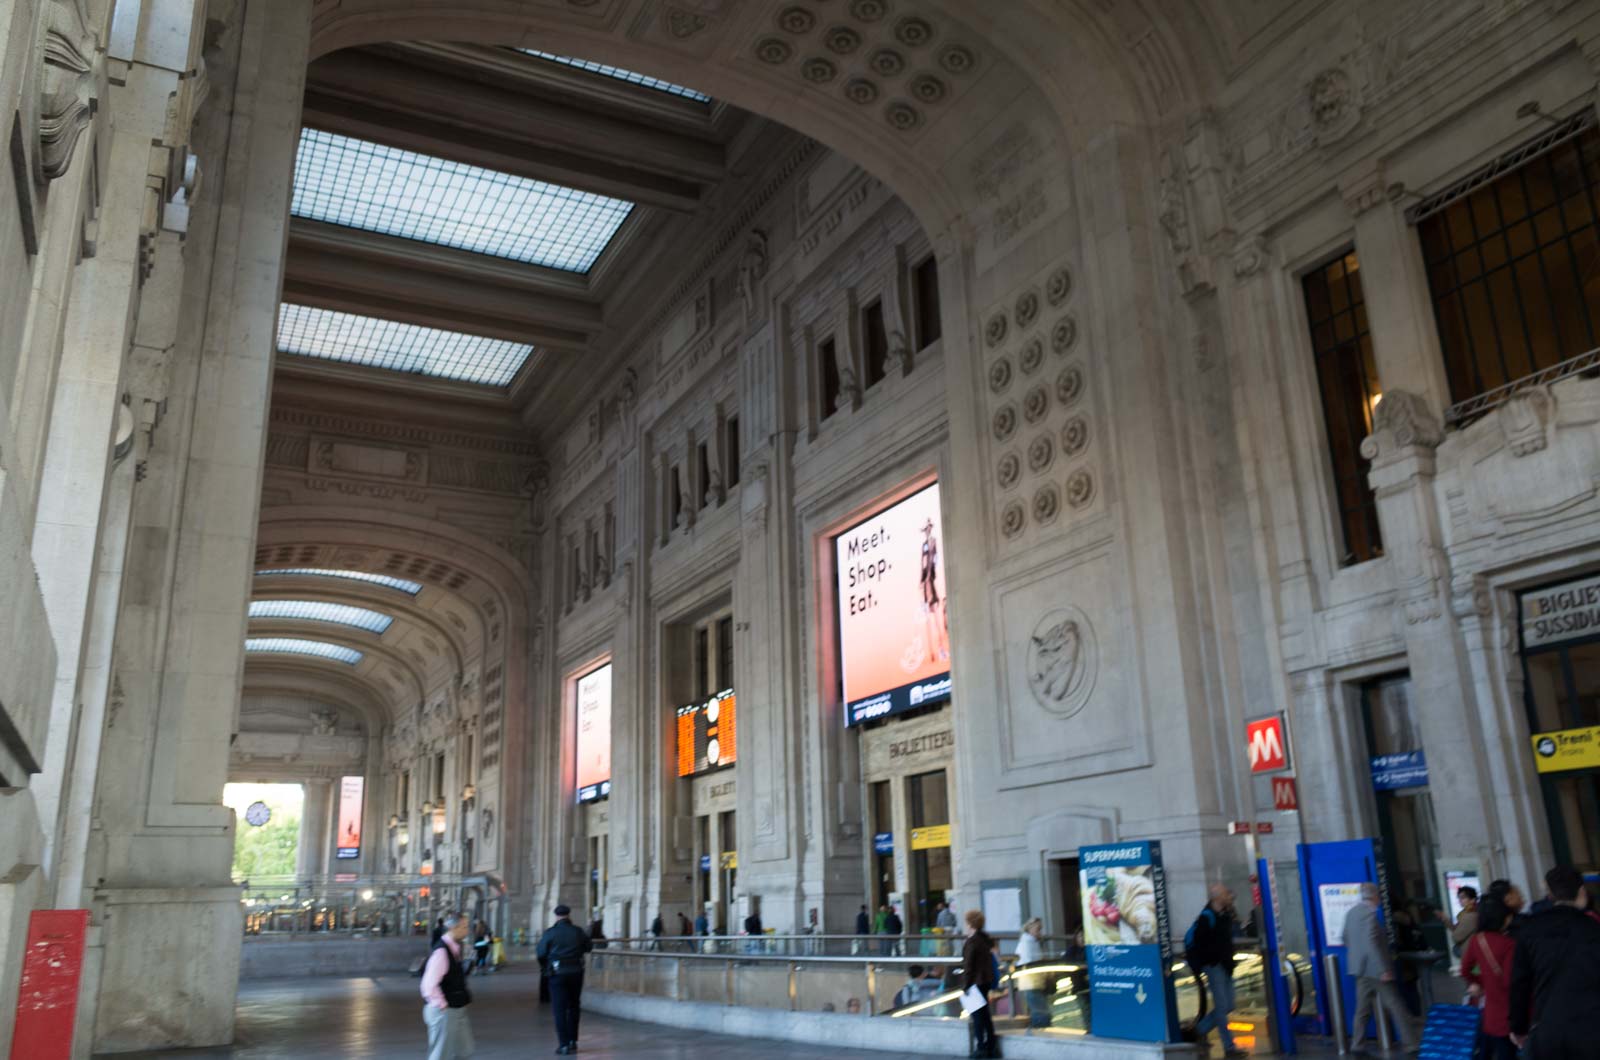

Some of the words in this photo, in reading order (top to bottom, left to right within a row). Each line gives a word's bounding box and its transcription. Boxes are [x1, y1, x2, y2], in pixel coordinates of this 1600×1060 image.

[847, 525, 891, 561] Meet.
[848, 557, 892, 588] Shop.
[849, 592, 878, 616] Eat.
[1251, 727, 1282, 767] M
[1275, 781, 1296, 807] M
[1084, 846, 1143, 864] SUPERMARKET
